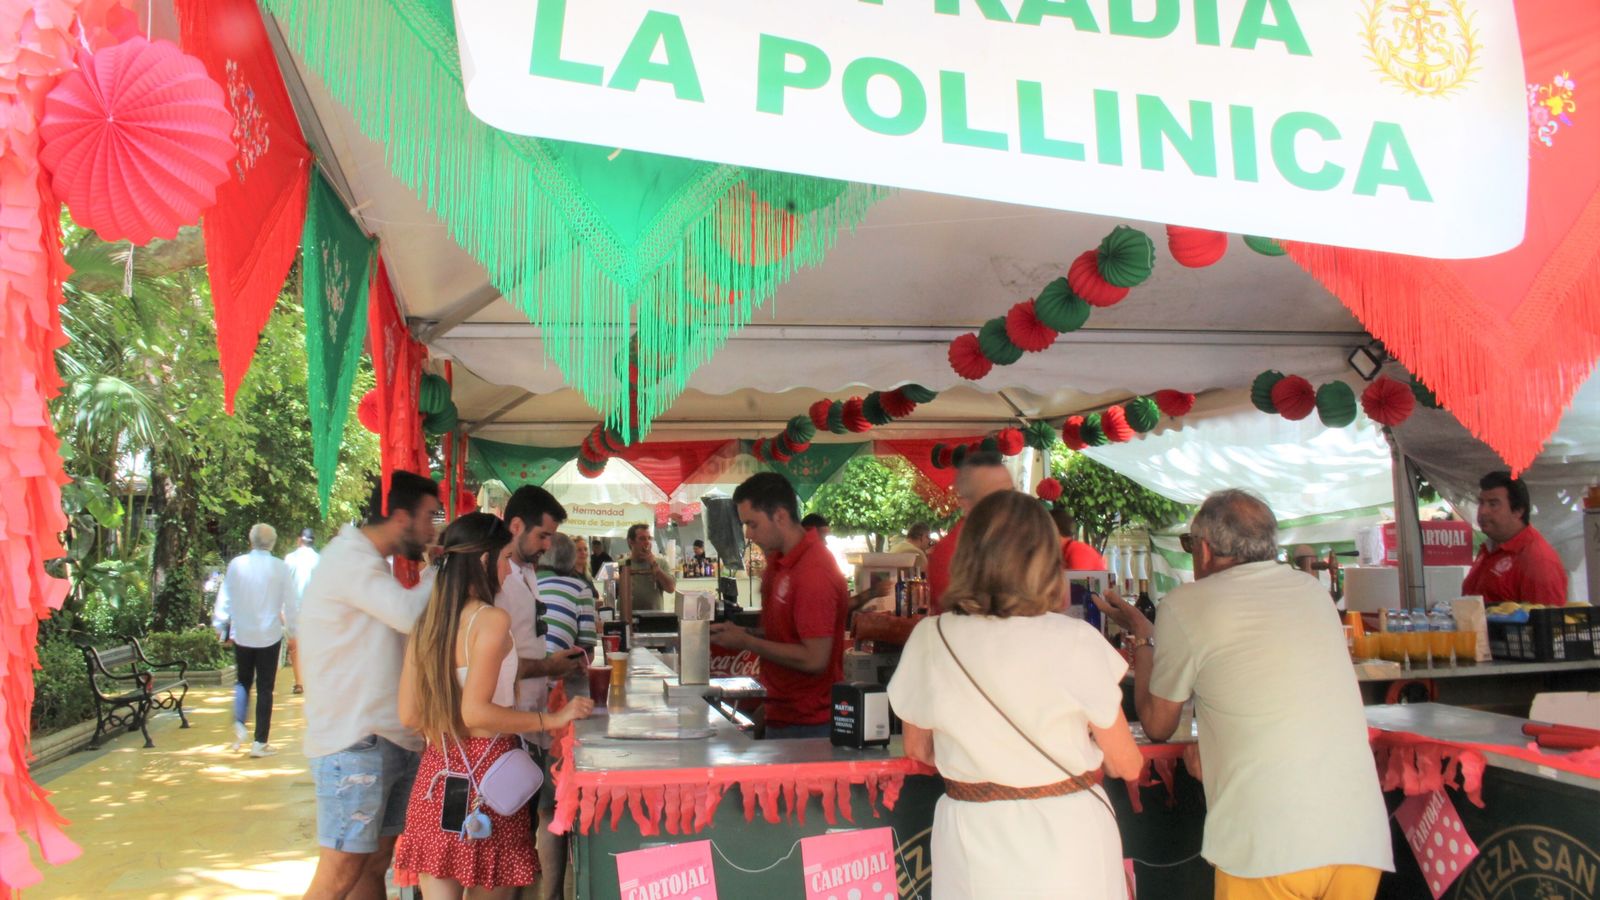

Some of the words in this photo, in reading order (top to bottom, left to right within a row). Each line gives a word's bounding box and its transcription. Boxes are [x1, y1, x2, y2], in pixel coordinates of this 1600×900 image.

[529, 0, 705, 103] LA
[756, 33, 1434, 203] POLLINICA
[573, 506, 625, 516] Hermandad
[1422, 529, 1467, 548] ARTOJAL
[1412, 790, 1445, 853] CARTOJAL
[628, 865, 709, 900] CARTOJAL
[811, 851, 890, 894] CARTOJAL
[1465, 839, 1528, 900] VEZA
[1532, 836, 1597, 894] SAN
